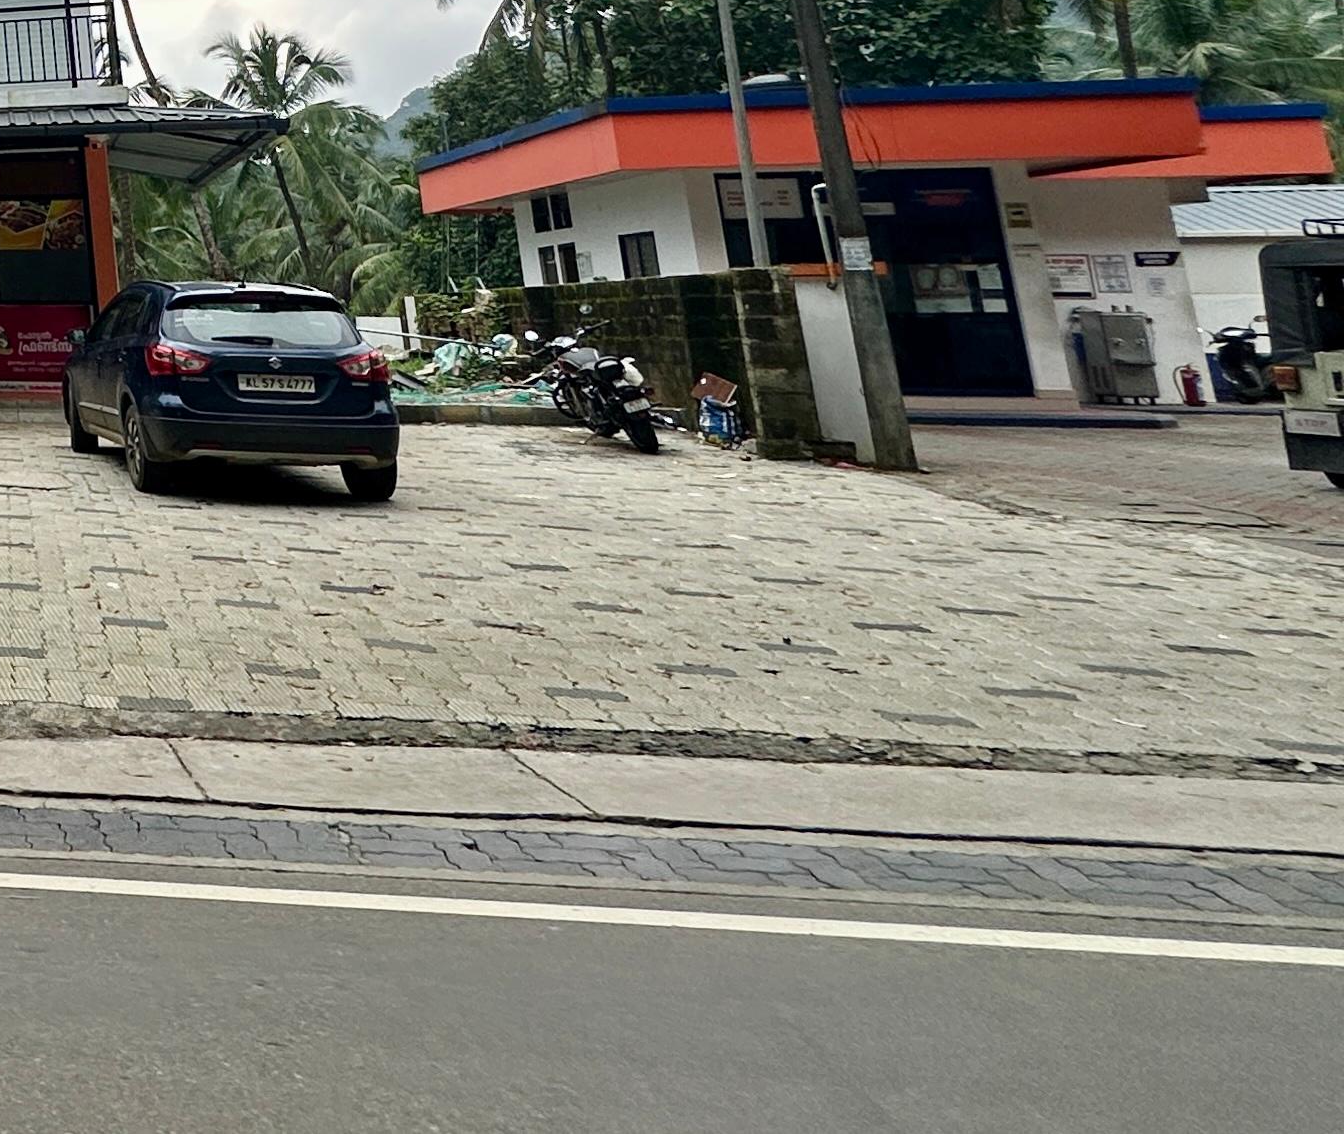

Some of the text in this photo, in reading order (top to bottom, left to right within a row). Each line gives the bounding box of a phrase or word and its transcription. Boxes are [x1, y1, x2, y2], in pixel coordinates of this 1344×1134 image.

[246, 377, 313, 390] KL 57 S 4777
